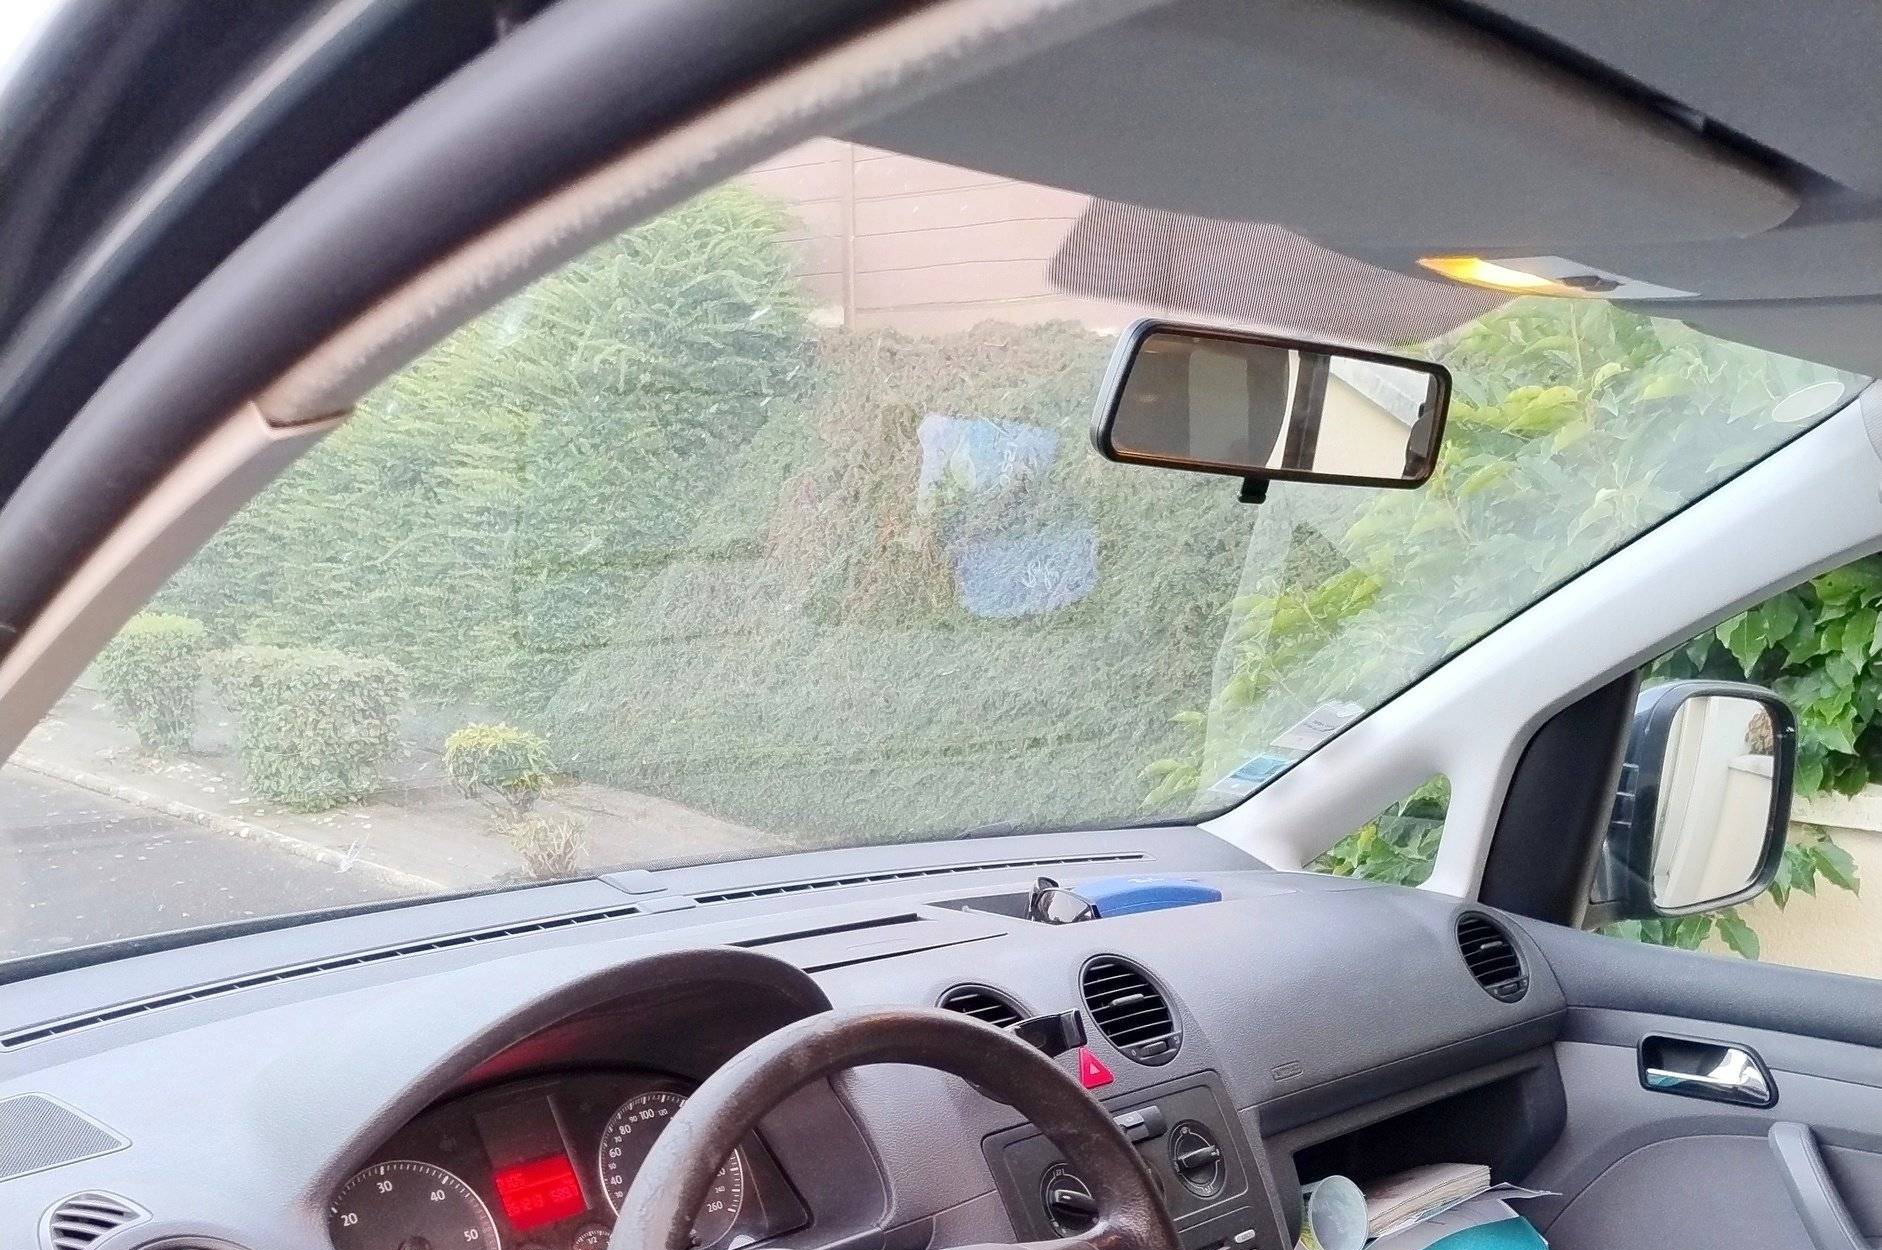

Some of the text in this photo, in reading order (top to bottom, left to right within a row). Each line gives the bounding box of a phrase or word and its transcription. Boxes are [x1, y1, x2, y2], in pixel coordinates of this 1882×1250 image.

[629, 1115, 638, 1123] 90
[639, 1109, 654, 1120] 100
[619, 1124, 631, 1135] 80
[609, 1148, 622, 1158] 60
[610, 1175, 622, 1185] 40
[376, 1180, 393, 1194] 30
[430, 1189, 446, 1201] 40
[707, 1200, 723, 1213] 260
[341, 1213, 358, 1226] 20
[464, 1229, 478, 1242] 50
